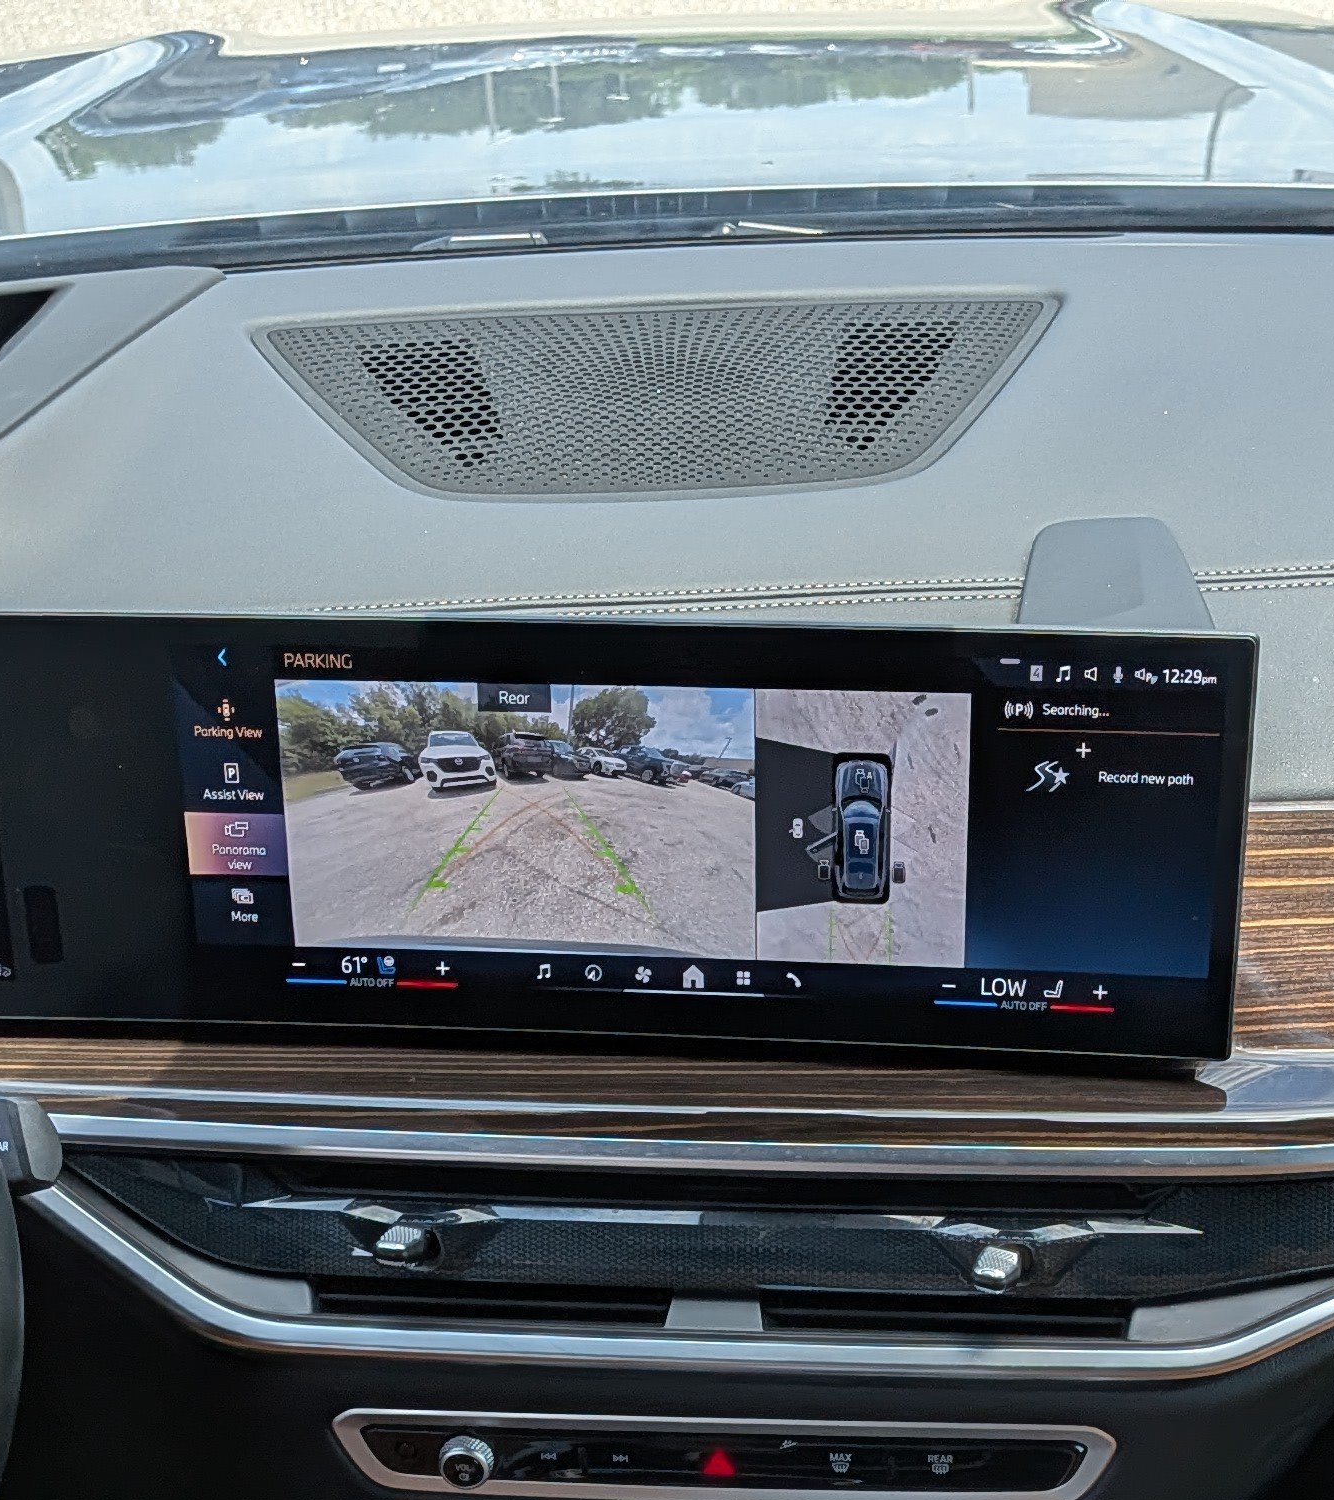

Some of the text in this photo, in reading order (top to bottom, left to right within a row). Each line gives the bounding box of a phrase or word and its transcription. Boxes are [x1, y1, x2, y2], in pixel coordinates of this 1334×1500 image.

[283, 652, 353, 669] PARKING
[498, 690, 530, 705] Rear
[1042, 703, 1110, 719] Searching...
[193, 725, 263, 739] Parking View
[1098, 771, 1194, 787] Record new path
[202, 787, 264, 801] Assist View
[211, 843, 267, 856] Panorama
[227, 859, 253, 870] view
[230, 910, 259, 923] More
[349, 978, 395, 988] AUTO OFF
[980, 977, 1027, 997] LOW
[1000, 1001, 1048, 1012] AUTO OFF
[829, 1452, 853, 1462] MAX
[927, 1453, 954, 1464] REAR
